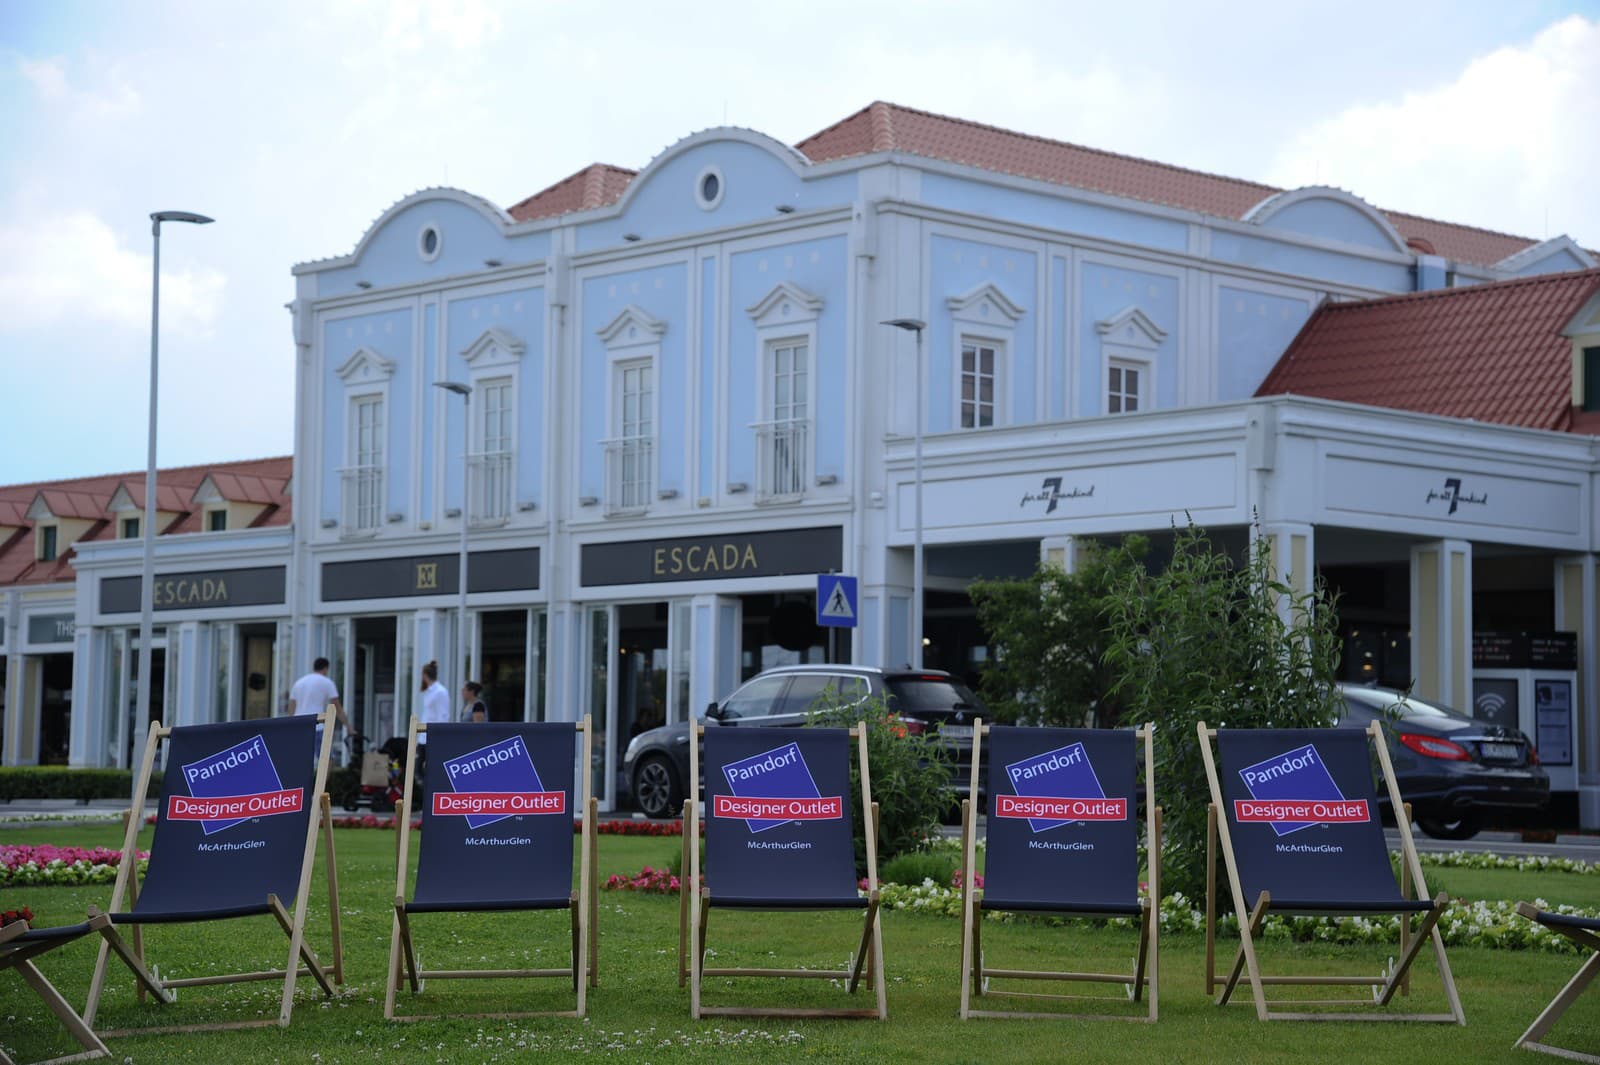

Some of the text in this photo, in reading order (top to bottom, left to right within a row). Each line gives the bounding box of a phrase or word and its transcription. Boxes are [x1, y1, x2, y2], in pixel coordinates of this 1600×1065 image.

[1042, 476, 1063, 514] 7
[1444, 478, 1461, 515] 7
[655, 543, 758, 575] ESCADA
[154, 578, 228, 605] ESCADA
[187, 740, 262, 783] Parndorf
[449, 740, 521, 778] Parndorf
[727, 747, 797, 783] Parndorf
[1011, 747, 1082, 783] Parndorf
[1245, 749, 1315, 787] Parndorf
[174, 793, 298, 818] Designer Outlet
[439, 795, 559, 812] Designer Outlet
[719, 799, 837, 817] Designer Outlet
[1002, 799, 1121, 817] Designer Outlet
[1241, 802, 1363, 820] Designer Outlet
[197, 839, 266, 852] McArthurGlen
[465, 837, 531, 846] McArthurGlen
[747, 841, 812, 850] McArthurGlen
[1029, 840, 1094, 851] McArthurGlen
[1275, 844, 1343, 854] McArthurGlen
